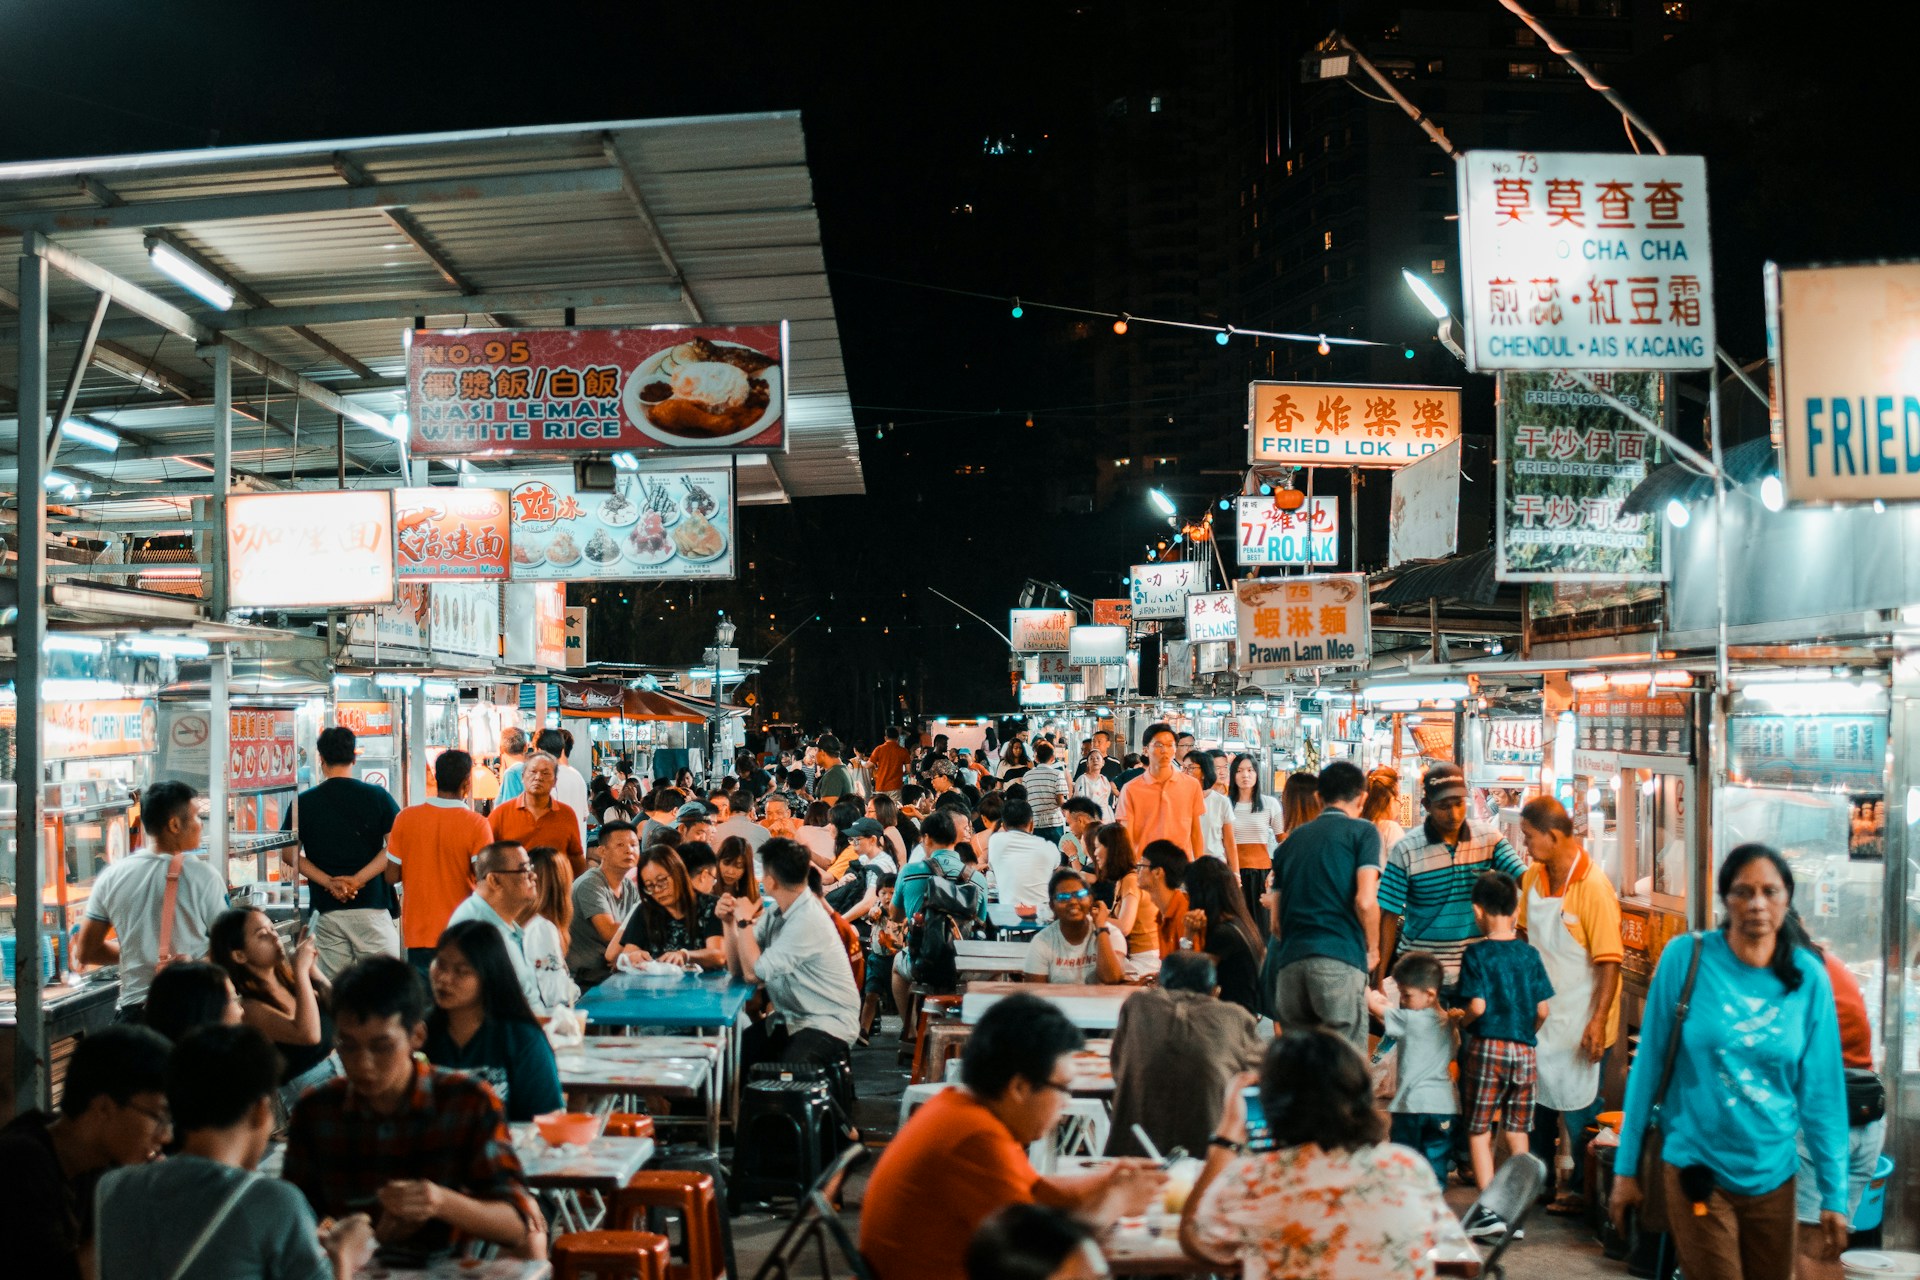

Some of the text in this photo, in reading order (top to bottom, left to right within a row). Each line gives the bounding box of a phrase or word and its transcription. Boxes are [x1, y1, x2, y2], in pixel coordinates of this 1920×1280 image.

[1492, 155, 1539, 174] No. 73
[1493, 177, 1685, 229] 莫莫查查
[1583, 239, 1630, 260] CHA
[1641, 239, 1689, 261] CHA
[1488, 336, 1704, 357] CHENDUL AIS KACANG
[1527, 392, 1568, 403] FRIED
[420, 402, 620, 421] NASI LEMAK
[421, 421, 620, 440] WHITE RICE
[1806, 396, 1920, 478] FRIED
[1262, 437, 1442, 457] FRIED LOK LO
[1517, 428, 1646, 460] 干炒伊面
[1517, 462, 1643, 477] FRIED DRY EE MEE
[1242, 523, 1267, 546] 77
[1513, 532, 1646, 546] FRIED DRY HOR FUN
[1268, 536, 1334, 561] ROJAK
[441, 565, 476, 574] Prawn
[481, 565, 504, 574] Mee
[1289, 585, 1309, 597] 75
[1195, 620, 1237, 638] PENANG
[1100, 656, 1112, 664] BEAN
[1249, 643, 1290, 663] Prawn
[1294, 641, 1322, 660] Lam
[1327, 639, 1354, 659] Mee
[91, 715, 120, 739] CURRY
[124, 715, 141, 738] MEE
